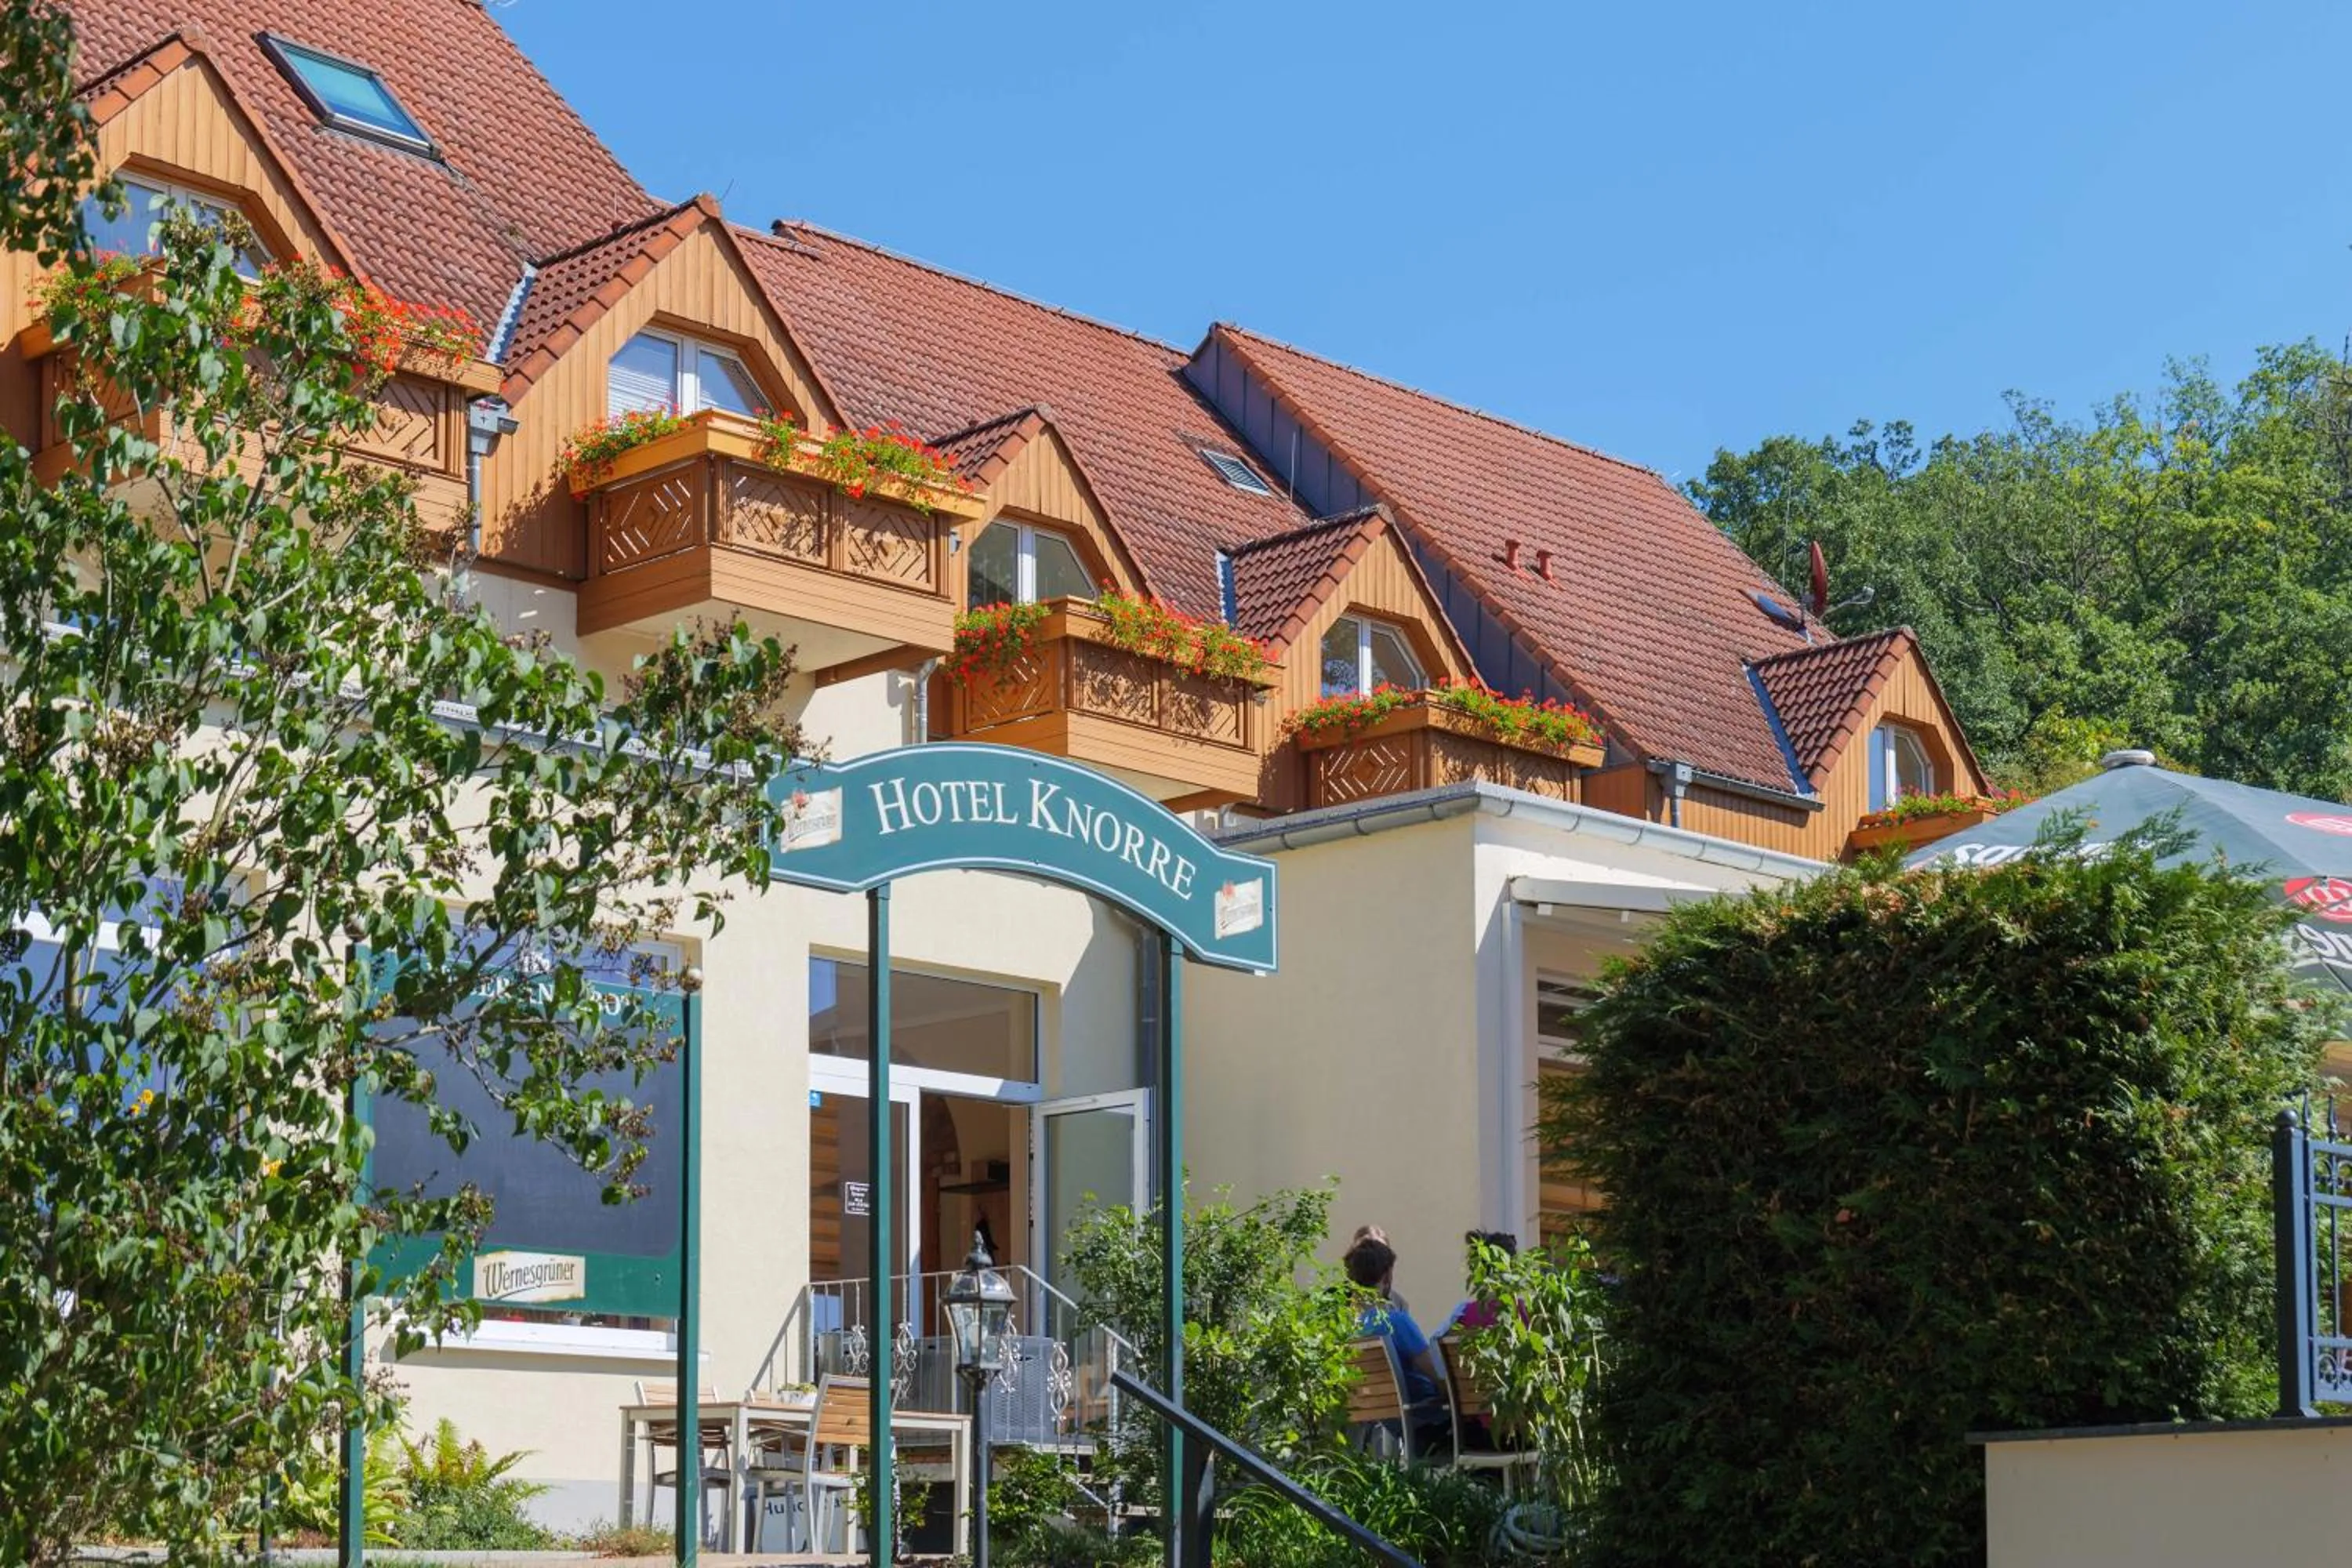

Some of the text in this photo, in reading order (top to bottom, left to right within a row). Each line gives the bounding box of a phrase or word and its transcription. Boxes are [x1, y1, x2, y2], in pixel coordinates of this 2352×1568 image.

[867, 777, 1196, 901] HOTEL KNORRE
[482, 1258, 575, 1298] Wernesgrüner
